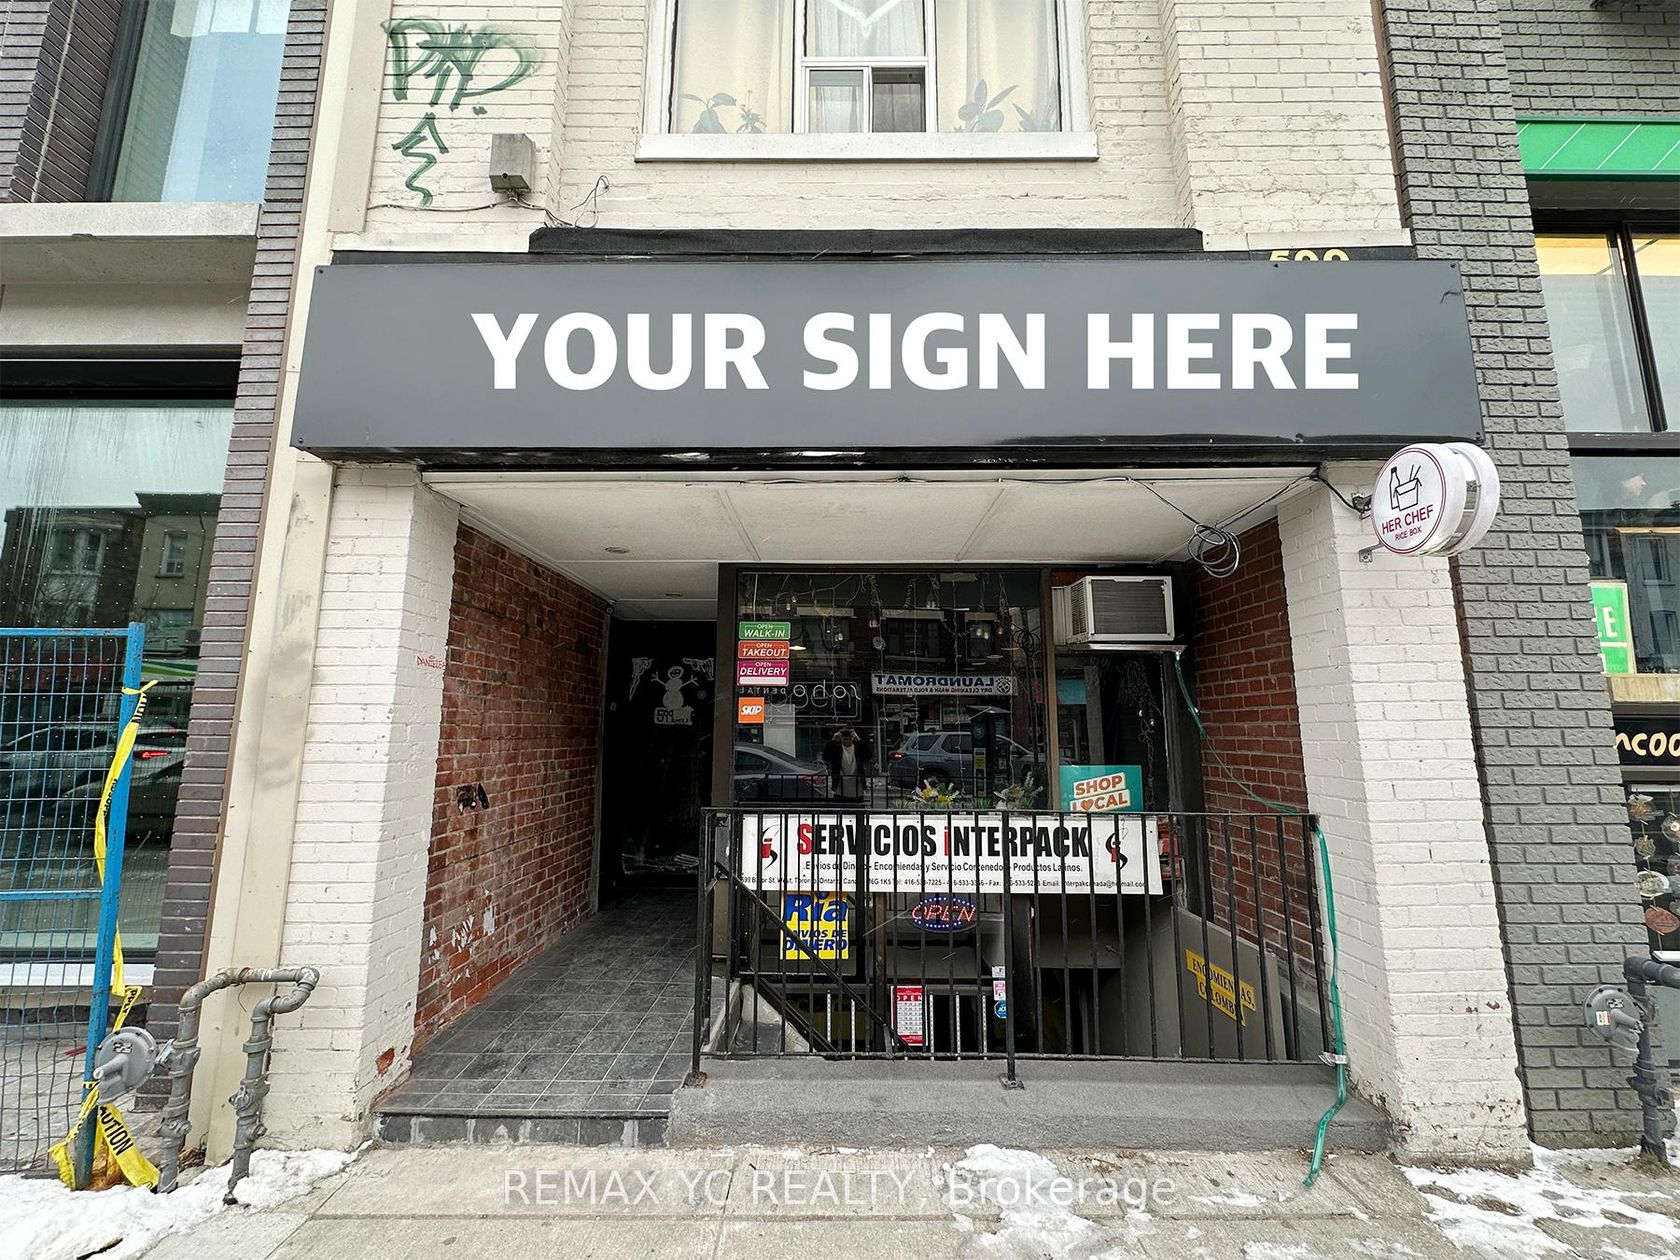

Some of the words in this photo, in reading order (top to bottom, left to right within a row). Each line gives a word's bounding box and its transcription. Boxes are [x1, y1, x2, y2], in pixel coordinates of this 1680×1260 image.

[472, 312, 769, 391] YOUR
[802, 312, 1046, 391] SIGN
[1087, 313, 1360, 390] HERE
[1381, 517, 1402, 535] HER
[1404, 504, 1434, 526] CHEF
[1395, 530, 1408, 541] RICE
[1410, 526, 1423, 537] BOX
[744, 628, 786, 638] WALK-IN
[742, 648, 787, 657] TAKEOUT
[739, 667, 787, 676] DELIVERY
[754, 660, 772, 668] OPEN
[740, 705, 763, 716] SKIP
[1075, 775, 1123, 796] SHOP
[797, 823, 937, 857] SERVICIOS
[944, 826, 1089, 858] iNTERPACK
[925, 864, 931, 873] y
[931, 862, 962, 871] Servcio
[962, 862, 1008, 872] Coenedo
[1053, 863, 1083, 872] Lainos.
[904, 878, 942, 887] 416-5-7225
[947, 879, 984, 887] 6-533-36
[1062, 880, 1147, 888] nterpakcada@hmail.co
[784, 891, 848, 922] Ria
[912, 905, 976, 922] OPEN
[784, 938, 848, 951] DERO
[1192, 958, 1255, 1009] ENCMIENAS,
[1199, 981, 1244, 1021] COMB
